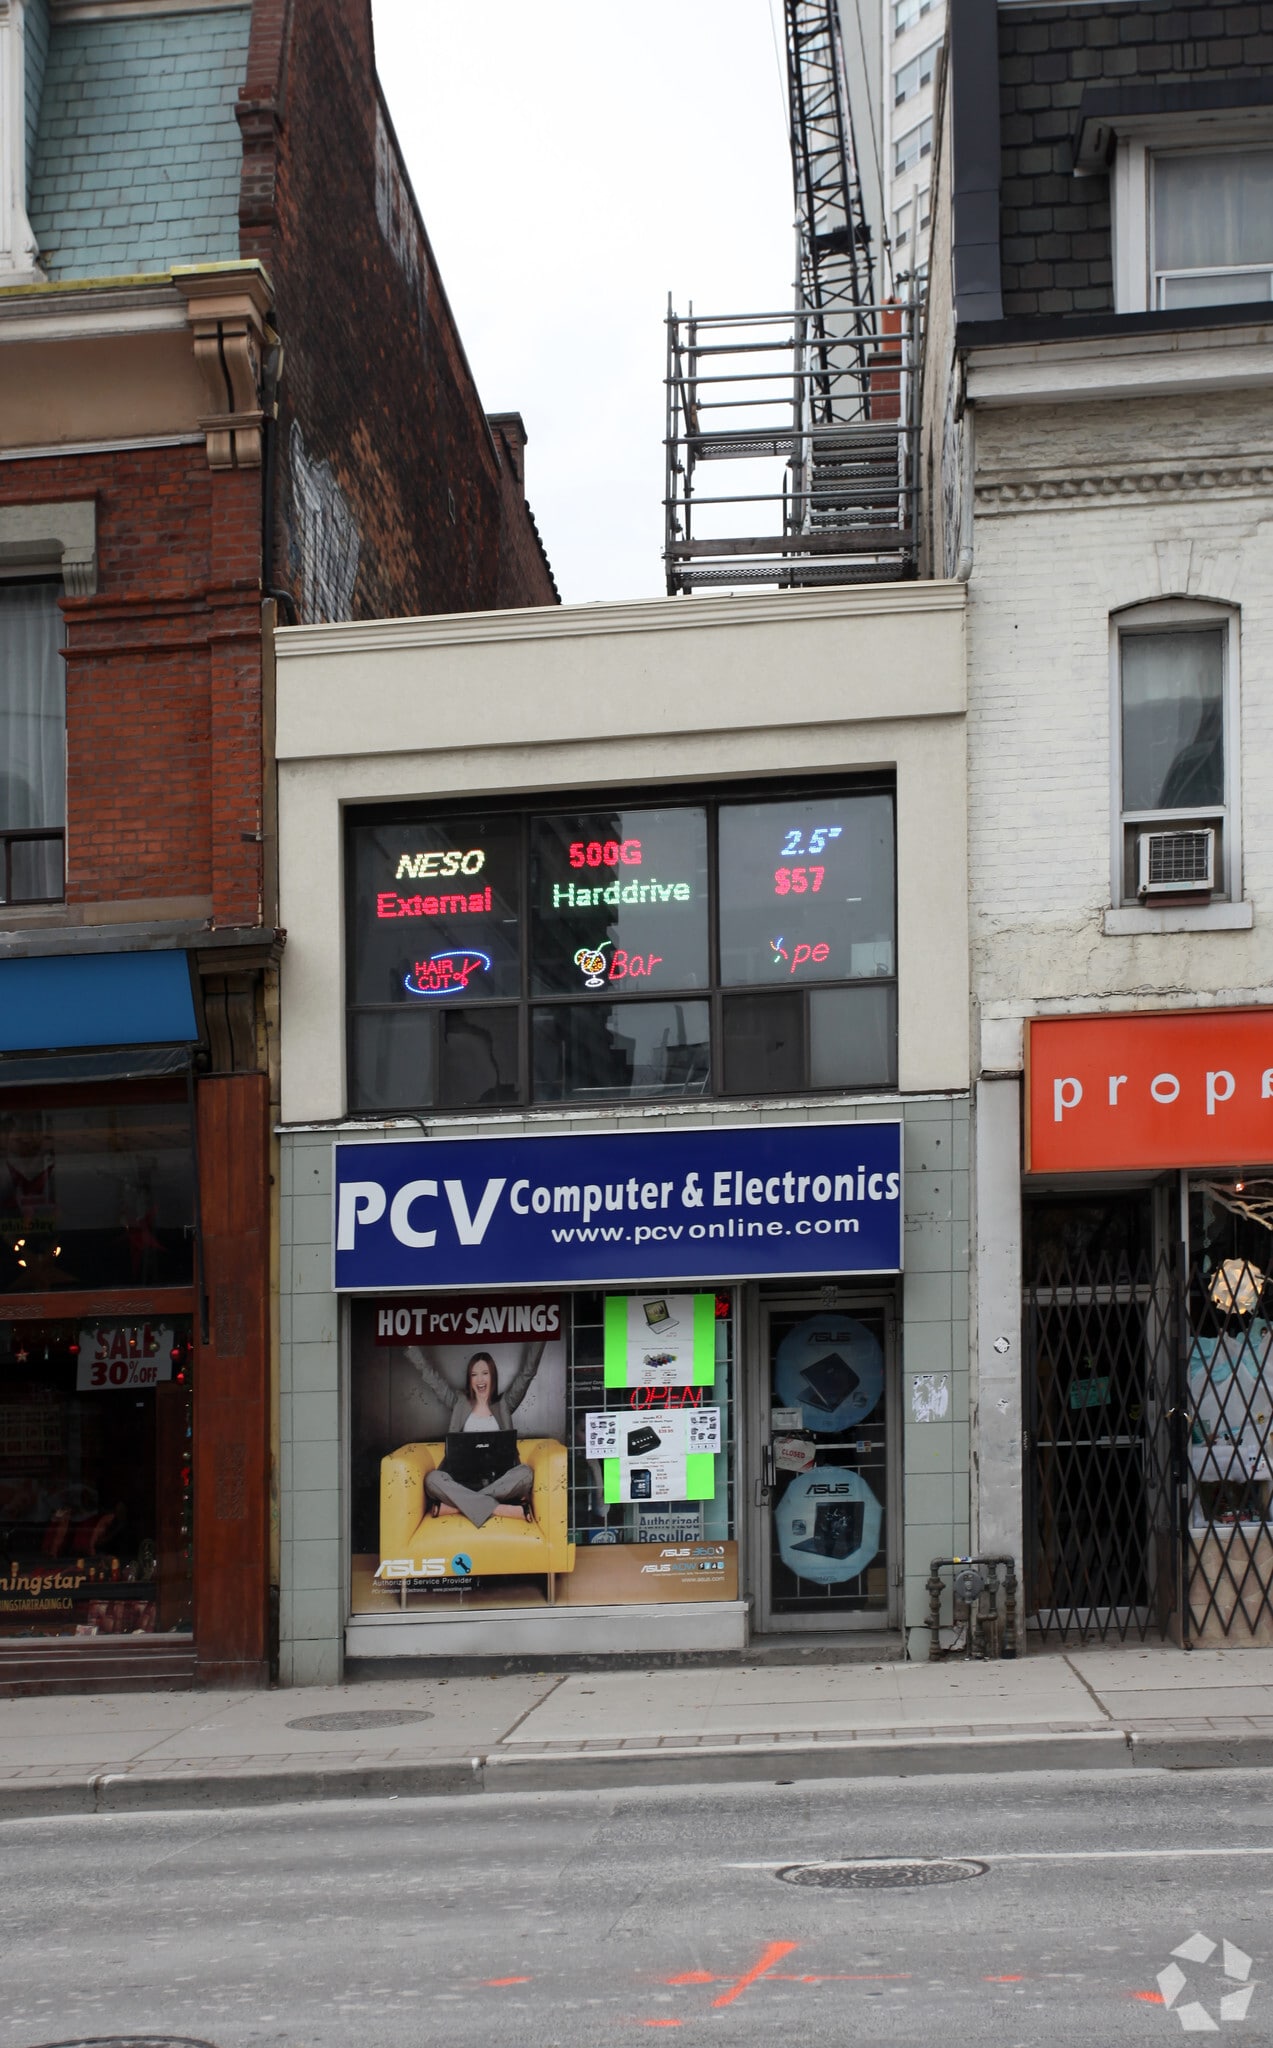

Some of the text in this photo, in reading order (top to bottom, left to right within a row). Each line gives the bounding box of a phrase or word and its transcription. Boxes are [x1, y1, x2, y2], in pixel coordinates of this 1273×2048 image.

[395, 849, 485, 879] NESO
[569, 840, 642, 868] 500G
[774, 865, 825, 895] $57
[376, 885, 492, 918] External
[553, 878, 690, 908] Harddrive
[415, 959, 453, 976] HAIR
[608, 949, 663, 980] Bar
[417, 974, 452, 990] CUT
[337, 1164, 900, 1250] PCV Computer & Electronics
[551, 1218, 860, 1245] www.pcvonline.com
[378, 1304, 560, 1336] HOT PCV SAVINGS
[94, 1323, 158, 1360] SALE
[806, 1331, 851, 1344] ASUS
[90, 1360, 158, 1387] 30% OFF
[629, 1385, 703, 1410] OPEN
[781, 1448, 806, 1459] CLOSED
[806, 1483, 850, 1494] ASUS
[639, 1516, 700, 1529] Authorized
[638, 1529, 700, 1543] Reseller
[659, 1548, 691, 1557] ASUS
[374, 1557, 446, 1578] ASUS
[640, 1564, 672, 1573] ASUS
[413, 1578, 440, 1586] Service
[442, 1576, 472, 1585] Provider
